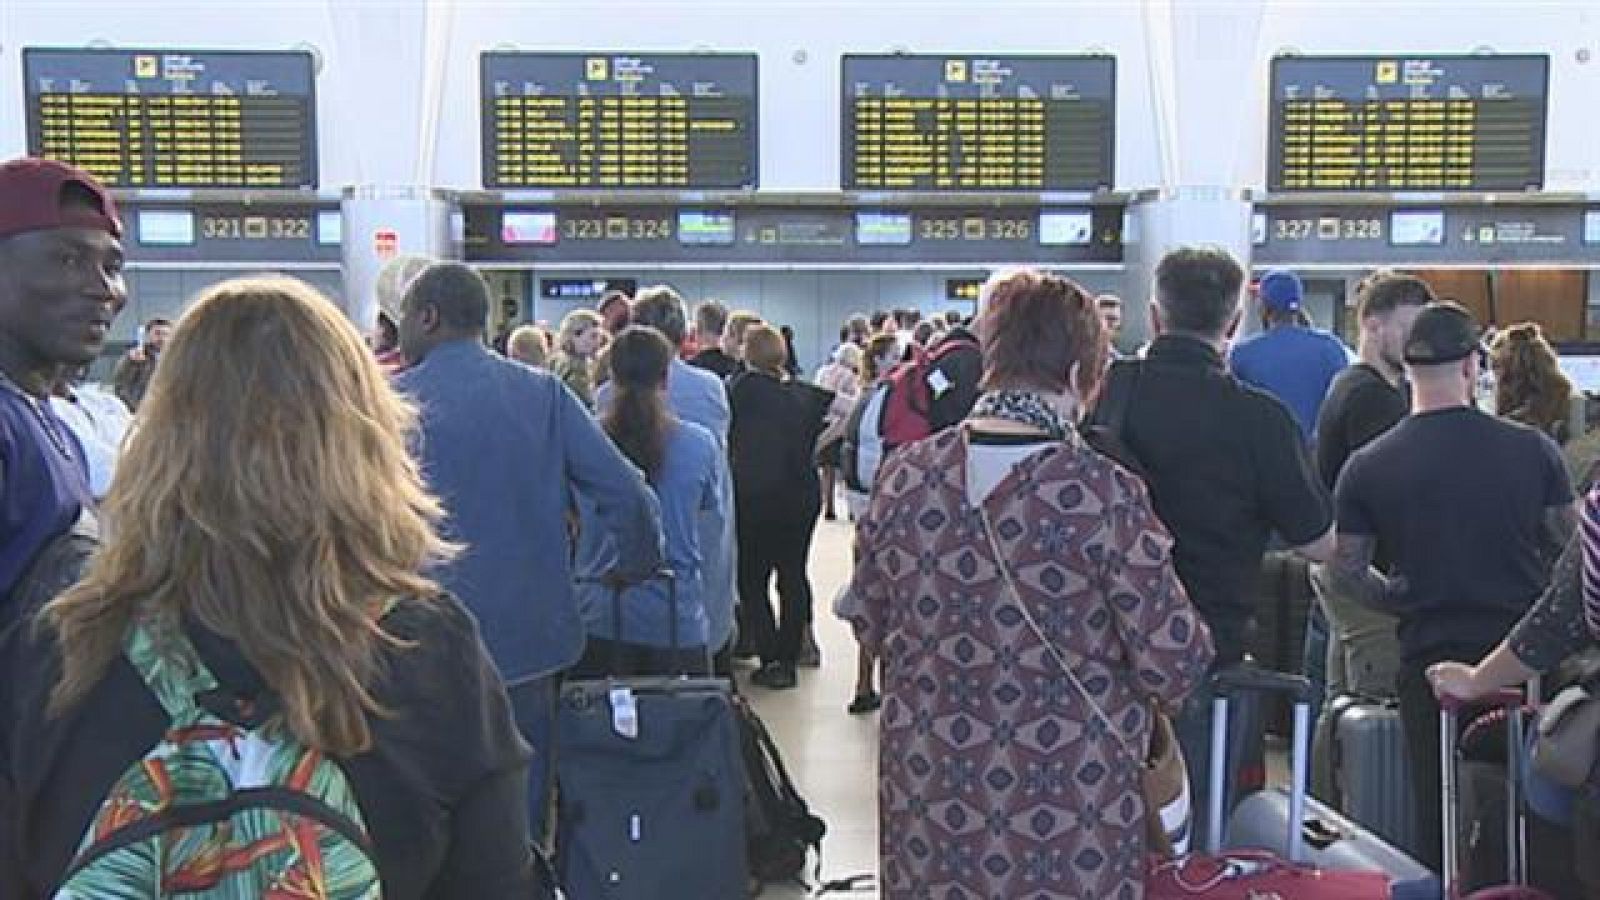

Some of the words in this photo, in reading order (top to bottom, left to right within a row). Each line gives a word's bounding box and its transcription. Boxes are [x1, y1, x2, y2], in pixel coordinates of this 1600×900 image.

[203, 217, 241, 239] 321
[270, 217, 310, 239] 322
[564, 218, 602, 239] 323
[631, 218, 671, 239] 324
[919, 219, 959, 240] 325
[990, 219, 1030, 240] 326
[1275, 219, 1313, 240] 327
[1342, 219, 1381, 240] 328
